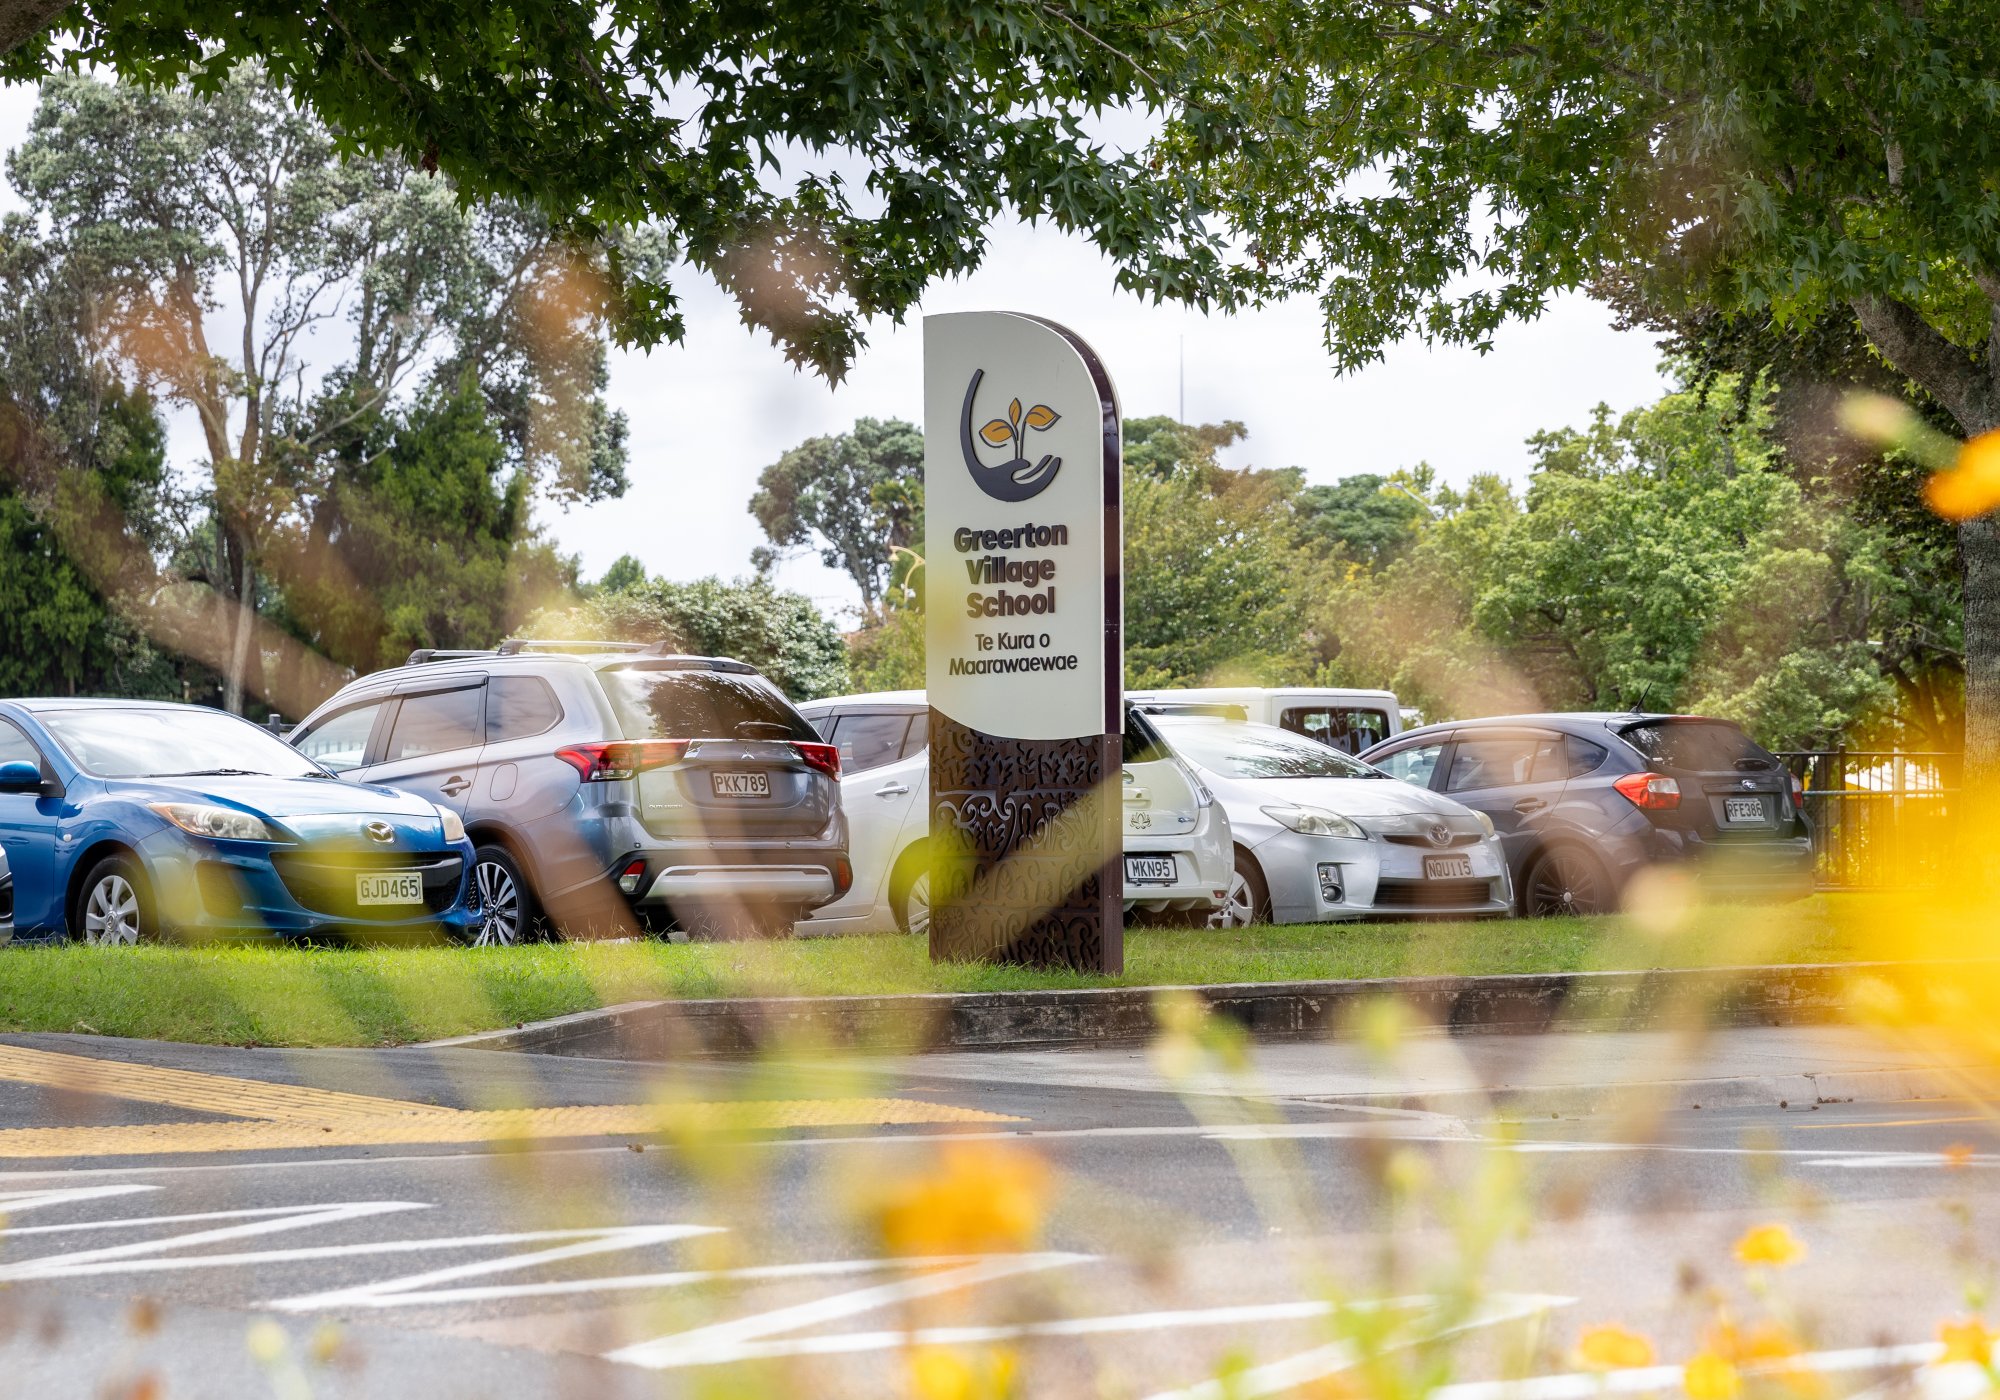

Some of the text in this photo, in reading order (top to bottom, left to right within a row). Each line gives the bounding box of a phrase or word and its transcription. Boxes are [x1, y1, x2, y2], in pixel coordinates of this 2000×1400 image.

[953, 522, 1068, 553] Greerton
[965, 555, 1056, 588] Village
[966, 586, 1056, 619] School
[975, 632, 1050, 651] Te Kura o
[949, 654, 1078, 675] Maarawaewae
[714, 775, 767, 792] PKK789
[1727, 803, 1763, 817] RFE386
[1131, 861, 1171, 877] MKN95
[1428, 861, 1471, 877] NQU115
[360, 879, 419, 898] GJD465
